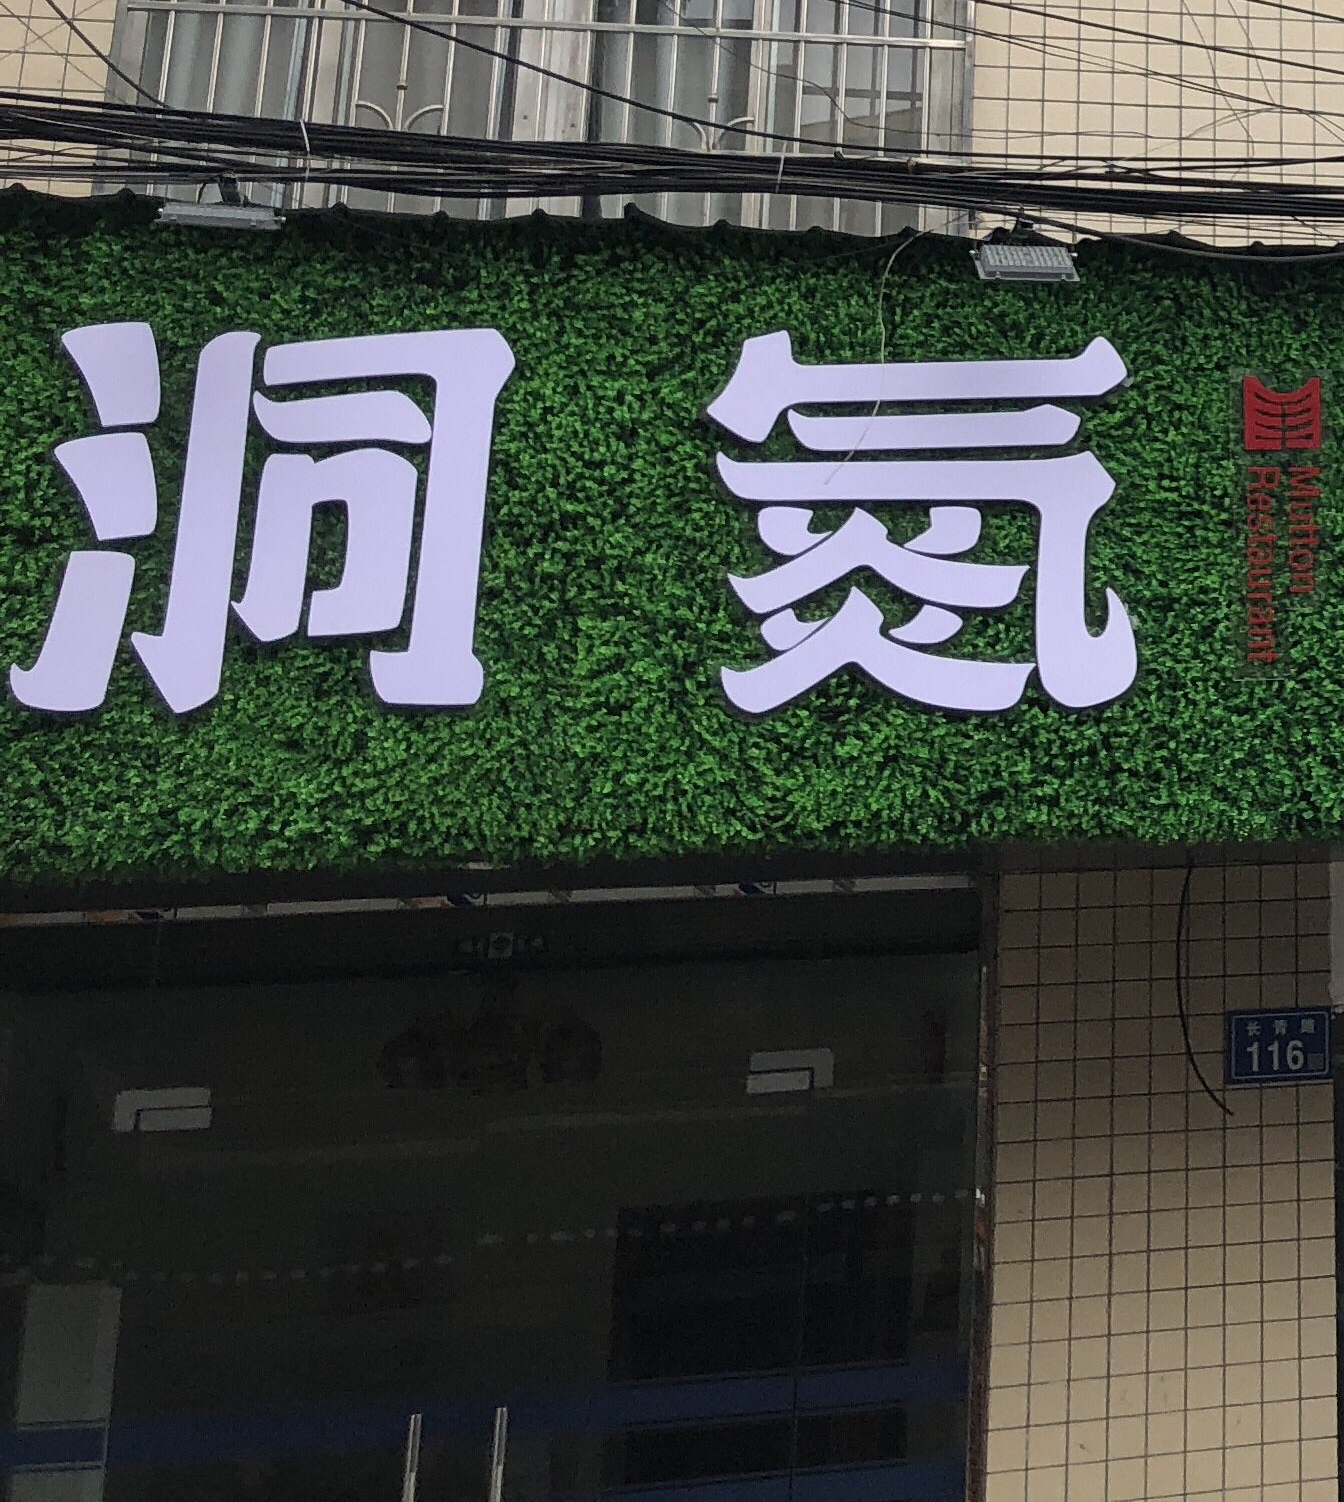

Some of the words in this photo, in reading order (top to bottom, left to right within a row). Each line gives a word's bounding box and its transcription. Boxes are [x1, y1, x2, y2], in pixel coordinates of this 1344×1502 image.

[1246, 466, 1282, 664] Restaurant
[1287, 466, 1322, 594] Mutton
[1246, 1039, 1305, 1072] 116
